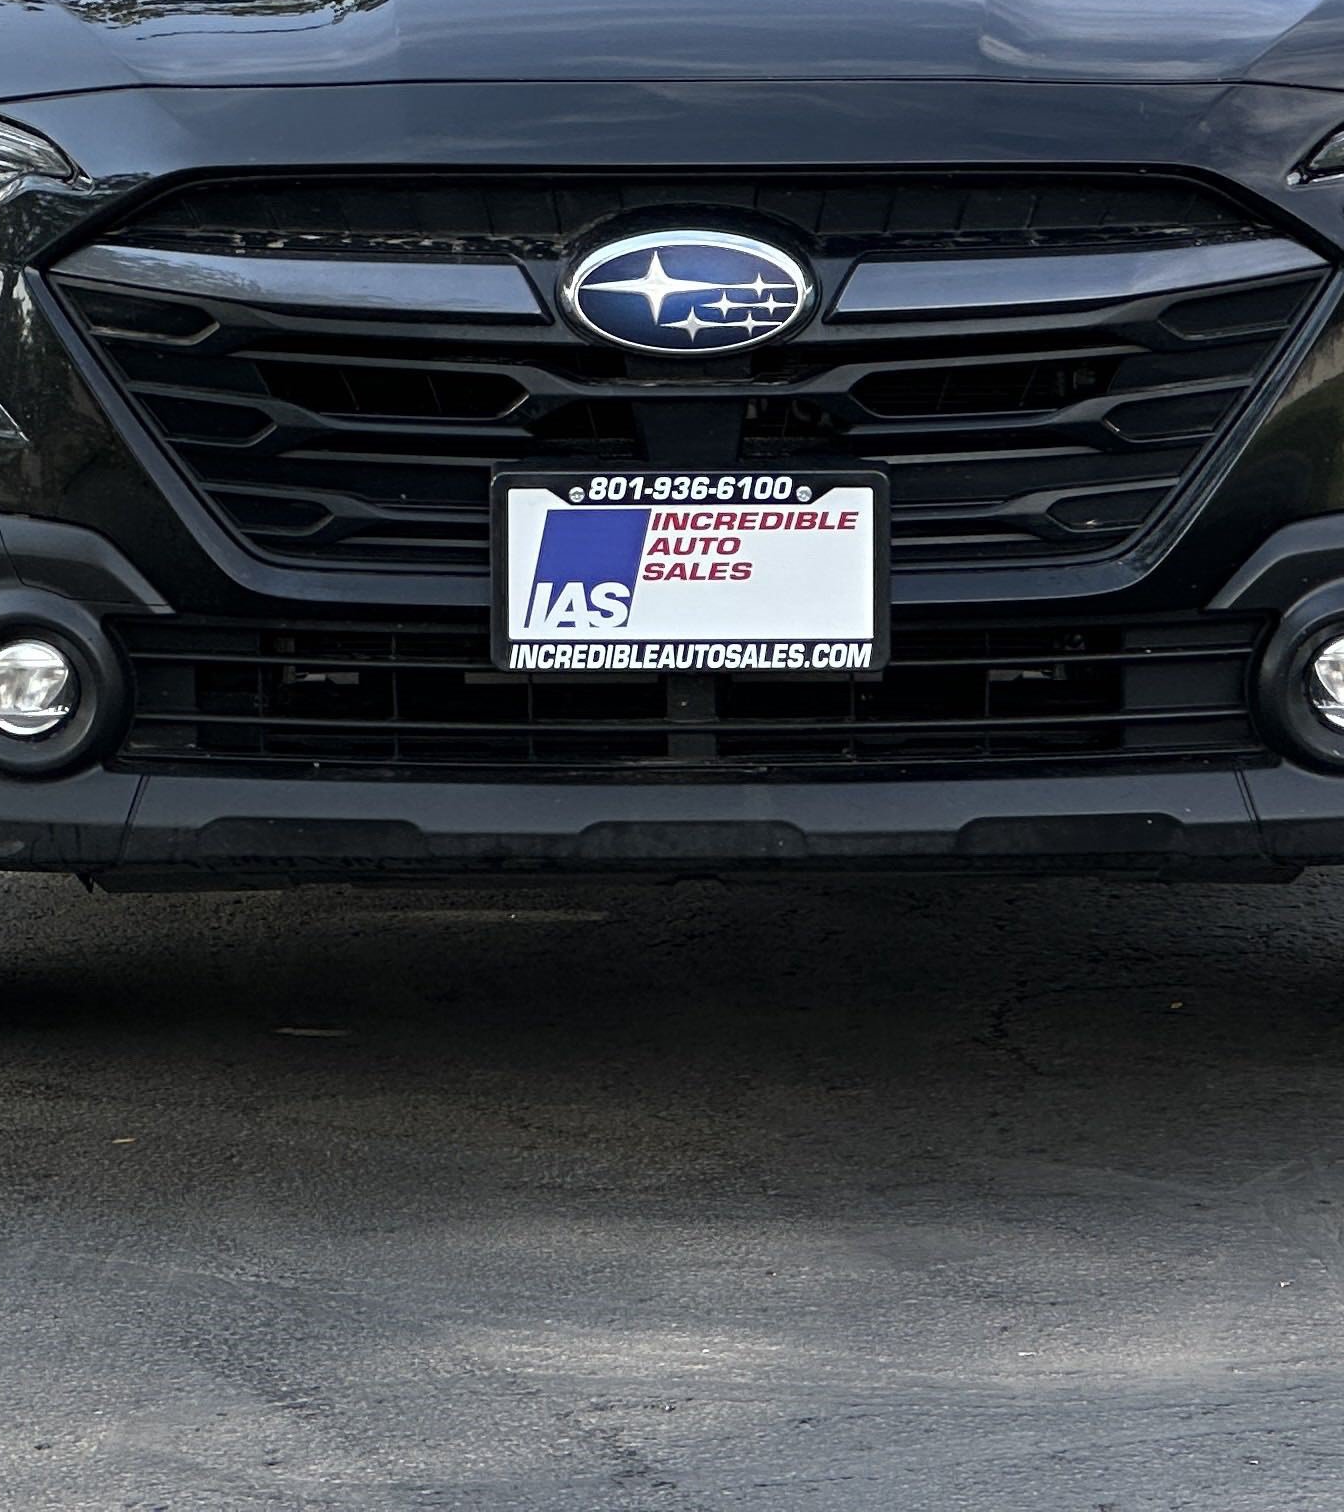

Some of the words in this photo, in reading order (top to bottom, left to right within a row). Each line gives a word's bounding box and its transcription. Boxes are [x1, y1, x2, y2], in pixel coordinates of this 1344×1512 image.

[588, 476, 793, 501] 801-936-6100
[651, 511, 859, 531] INCREDIBLE
[646, 536, 742, 556] AUTO
[642, 561, 753, 581] SALES
[529, 581, 632, 628] IAS
[509, 643, 873, 670] INCREDIBLEAUTOSALES.COM
